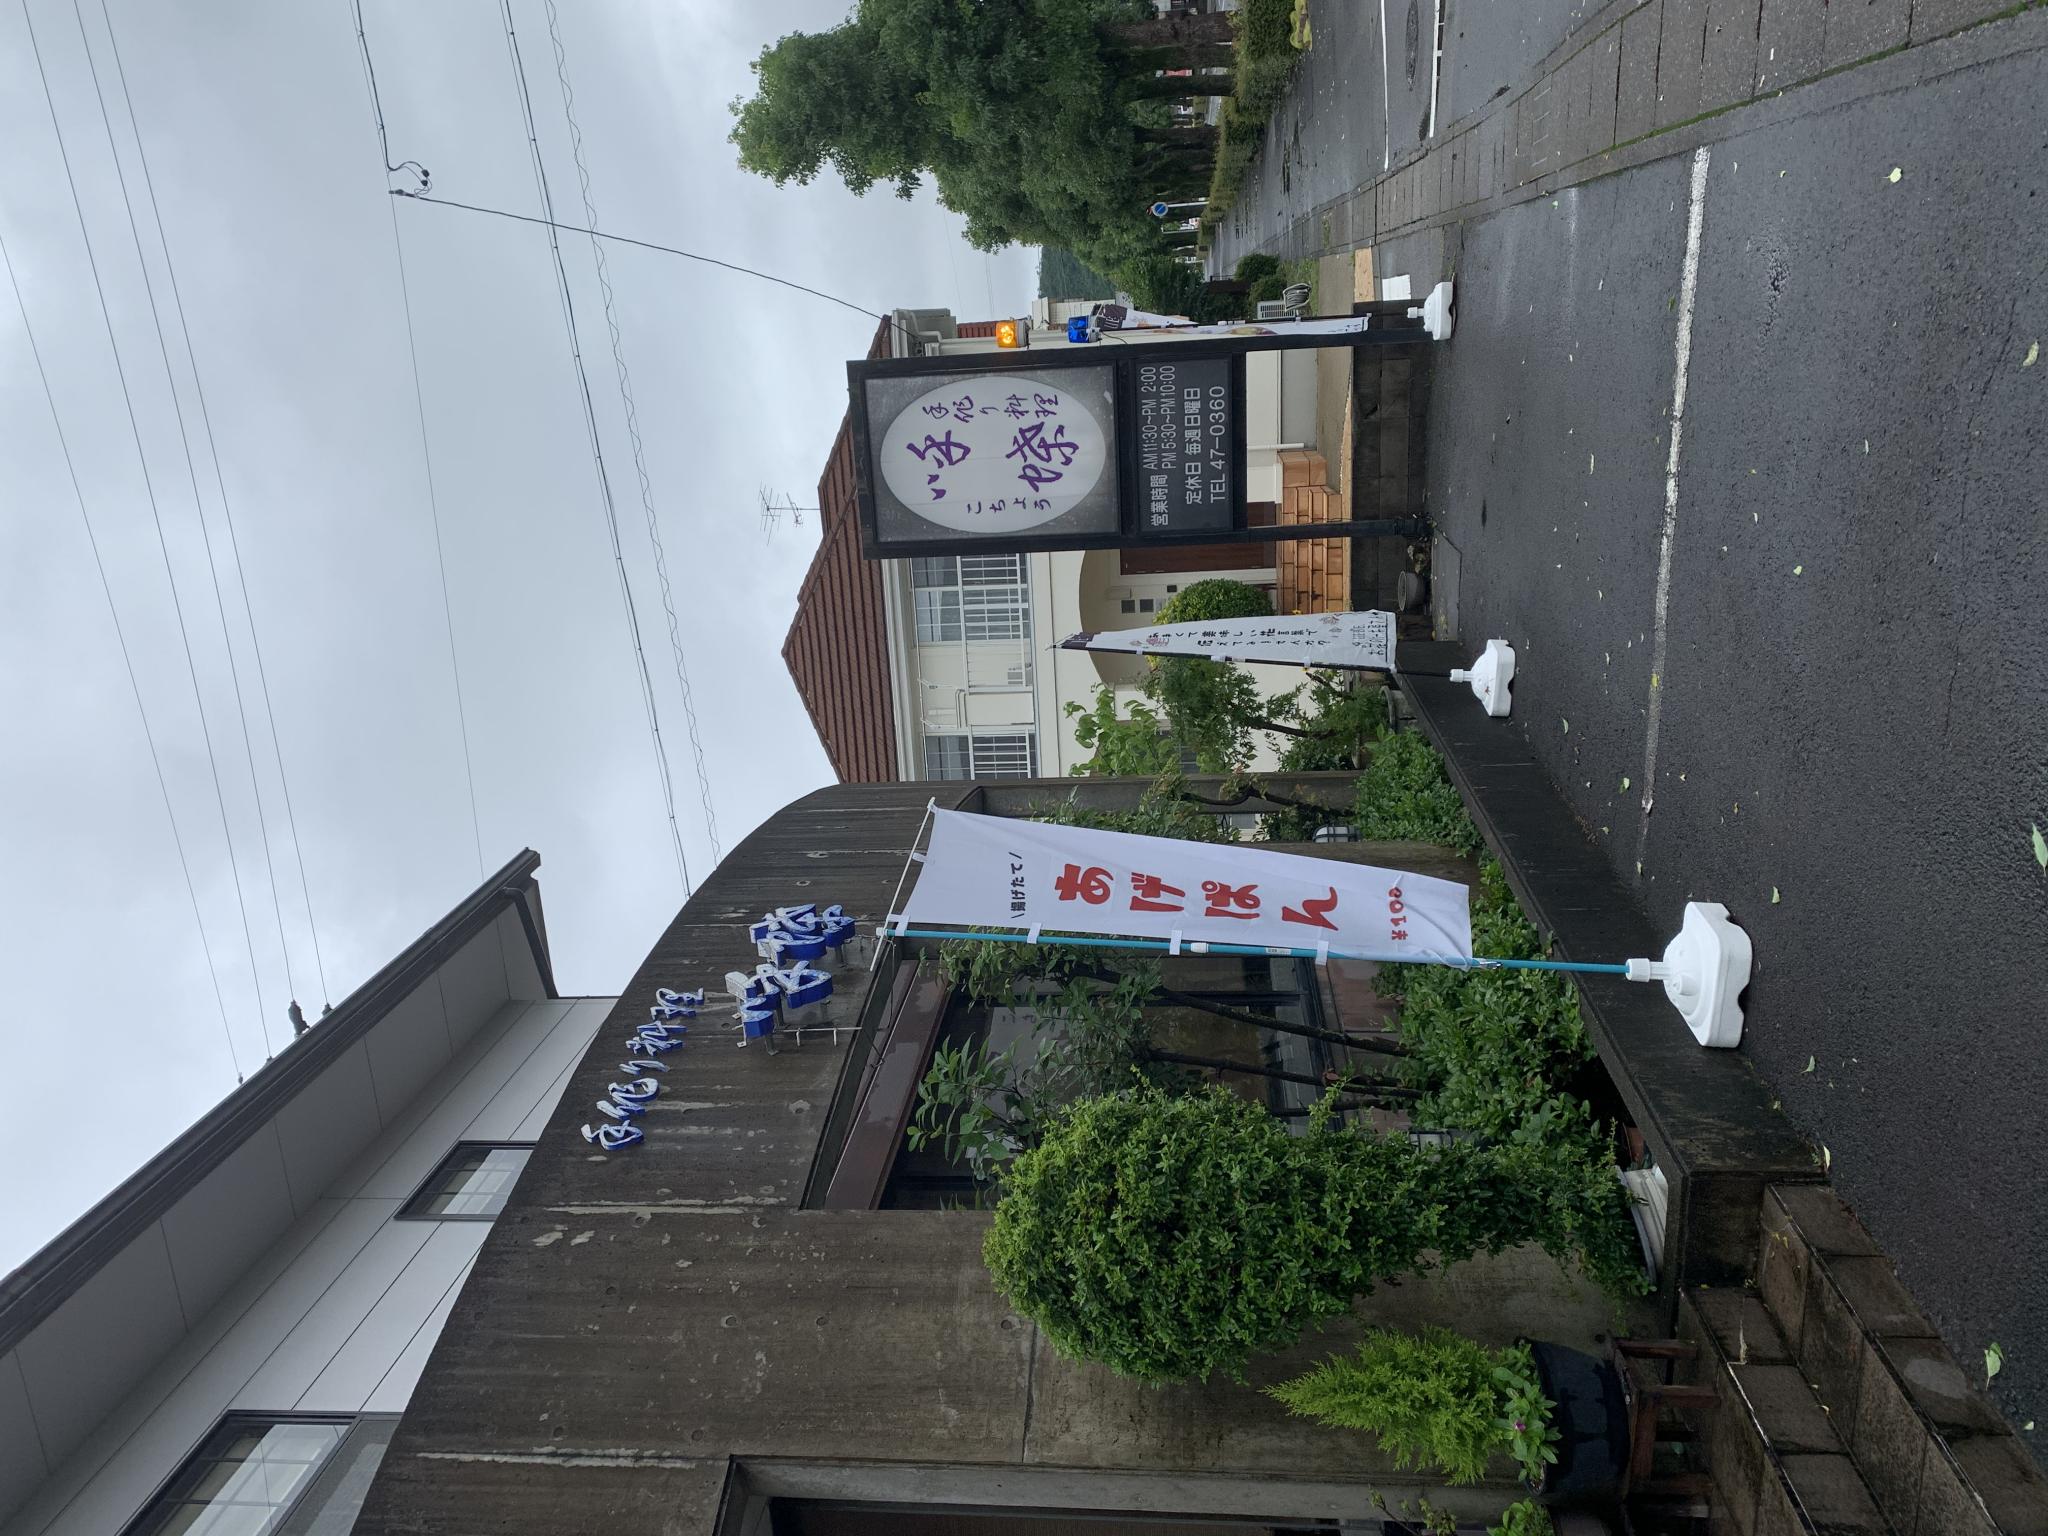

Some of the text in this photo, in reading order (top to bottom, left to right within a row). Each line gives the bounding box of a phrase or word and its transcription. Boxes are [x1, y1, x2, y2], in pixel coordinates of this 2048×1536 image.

[922, 393, 1058, 424] 手作り料理
[906, 422, 1079, 500] 呼蝶
[1184, 388, 1202, 504] 定休日 毎週日曜日
[967, 497, 1051, 514] こちょう
[1150, 474, 1168, 526] 営業時間
[1210, 474, 1225, 503] TEL
[1055, 863, 1339, 930] あげぱん
[581, 988, 704, 1150] 手作り料理
